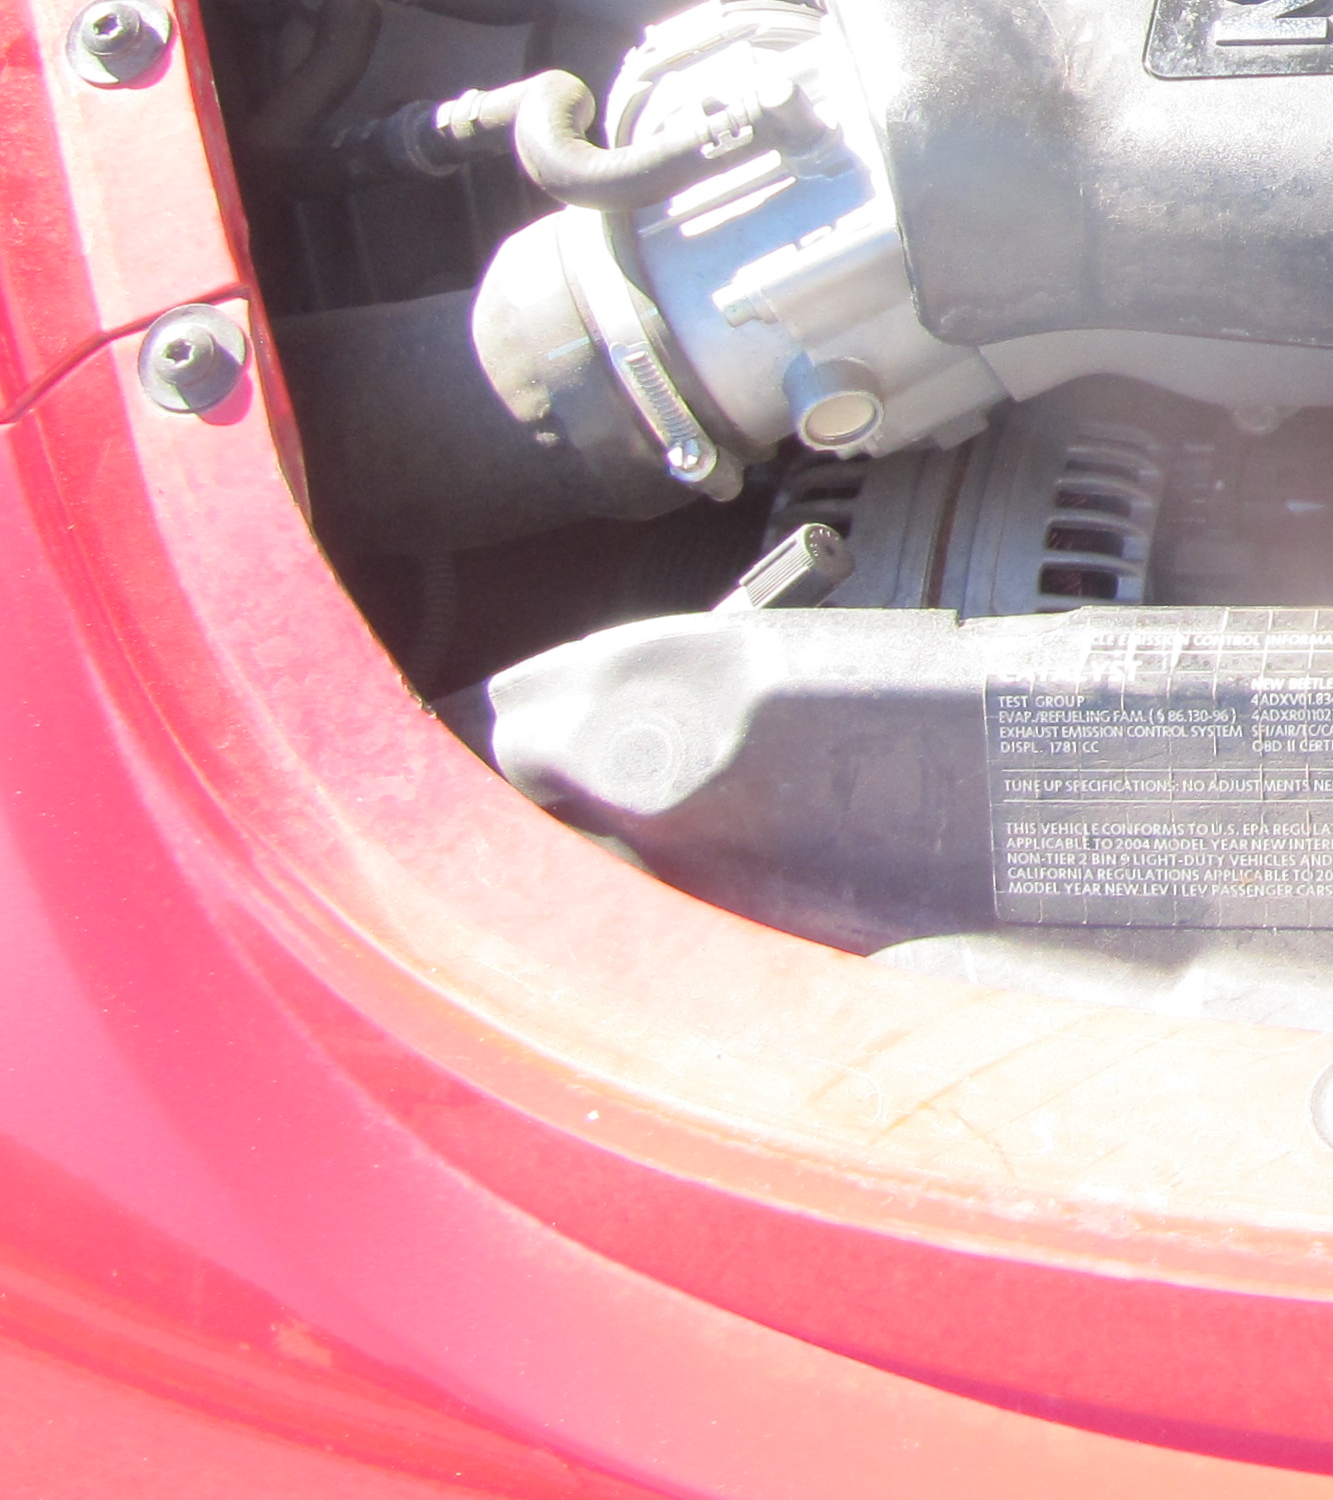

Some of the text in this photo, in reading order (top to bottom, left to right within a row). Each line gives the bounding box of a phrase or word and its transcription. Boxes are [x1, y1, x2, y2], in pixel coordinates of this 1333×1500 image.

[1194, 634, 1259, 646] CONTROL
[1289, 677, 1333, 689] BEETLE
[998, 696, 1085, 708] TEST GROUP
[999, 725, 1242, 738] EXHAUST EMISSION CONTROL SYSTEM
[1000, 741, 1099, 754] DISPL. 1781 CC
[1252, 740, 1282, 752] OBD
[1004, 779, 1041, 792] TUNE
[1044, 780, 1062, 792] UP
[1183, 780, 1205, 792] NO
[1209, 779, 1310, 793] ADJUSTMENTS
[1005, 822, 1037, 835] THIS
[1040, 823, 1099, 835] VEHICLE
[1102, 823, 1184, 836] CONFORMS
[1187, 823, 1208, 835] TO
[1211, 823, 1240, 835] U.S.
[1243, 823, 1269, 836] EPA
[1006, 838, 1286, 851] APPLICABLE TO 2004 MODEL YEAR NEW
[1007, 853, 1332, 866] NON-TIER 2 BIN 9 LIGHT-DUTY VEHICLES AND
[1008, 867, 1095, 880] CALIFORNIA
[1097, 868, 1199, 881] REGULATIONS
[1204, 869, 1288, 882] APPLICABLE
[1293, 869, 1314, 882] TO
[1009, 881, 1060, 893] MODEL
[1064, 882, 1102, 895] YEAR
[1105, 882, 1141, 895] NEW
[1143, 883, 1169, 895] LEV
[1181, 883, 1206, 896] LEV
[1212, 884, 1292, 897] PASSENGER
[1297, 883, 1333, 897] CARS
